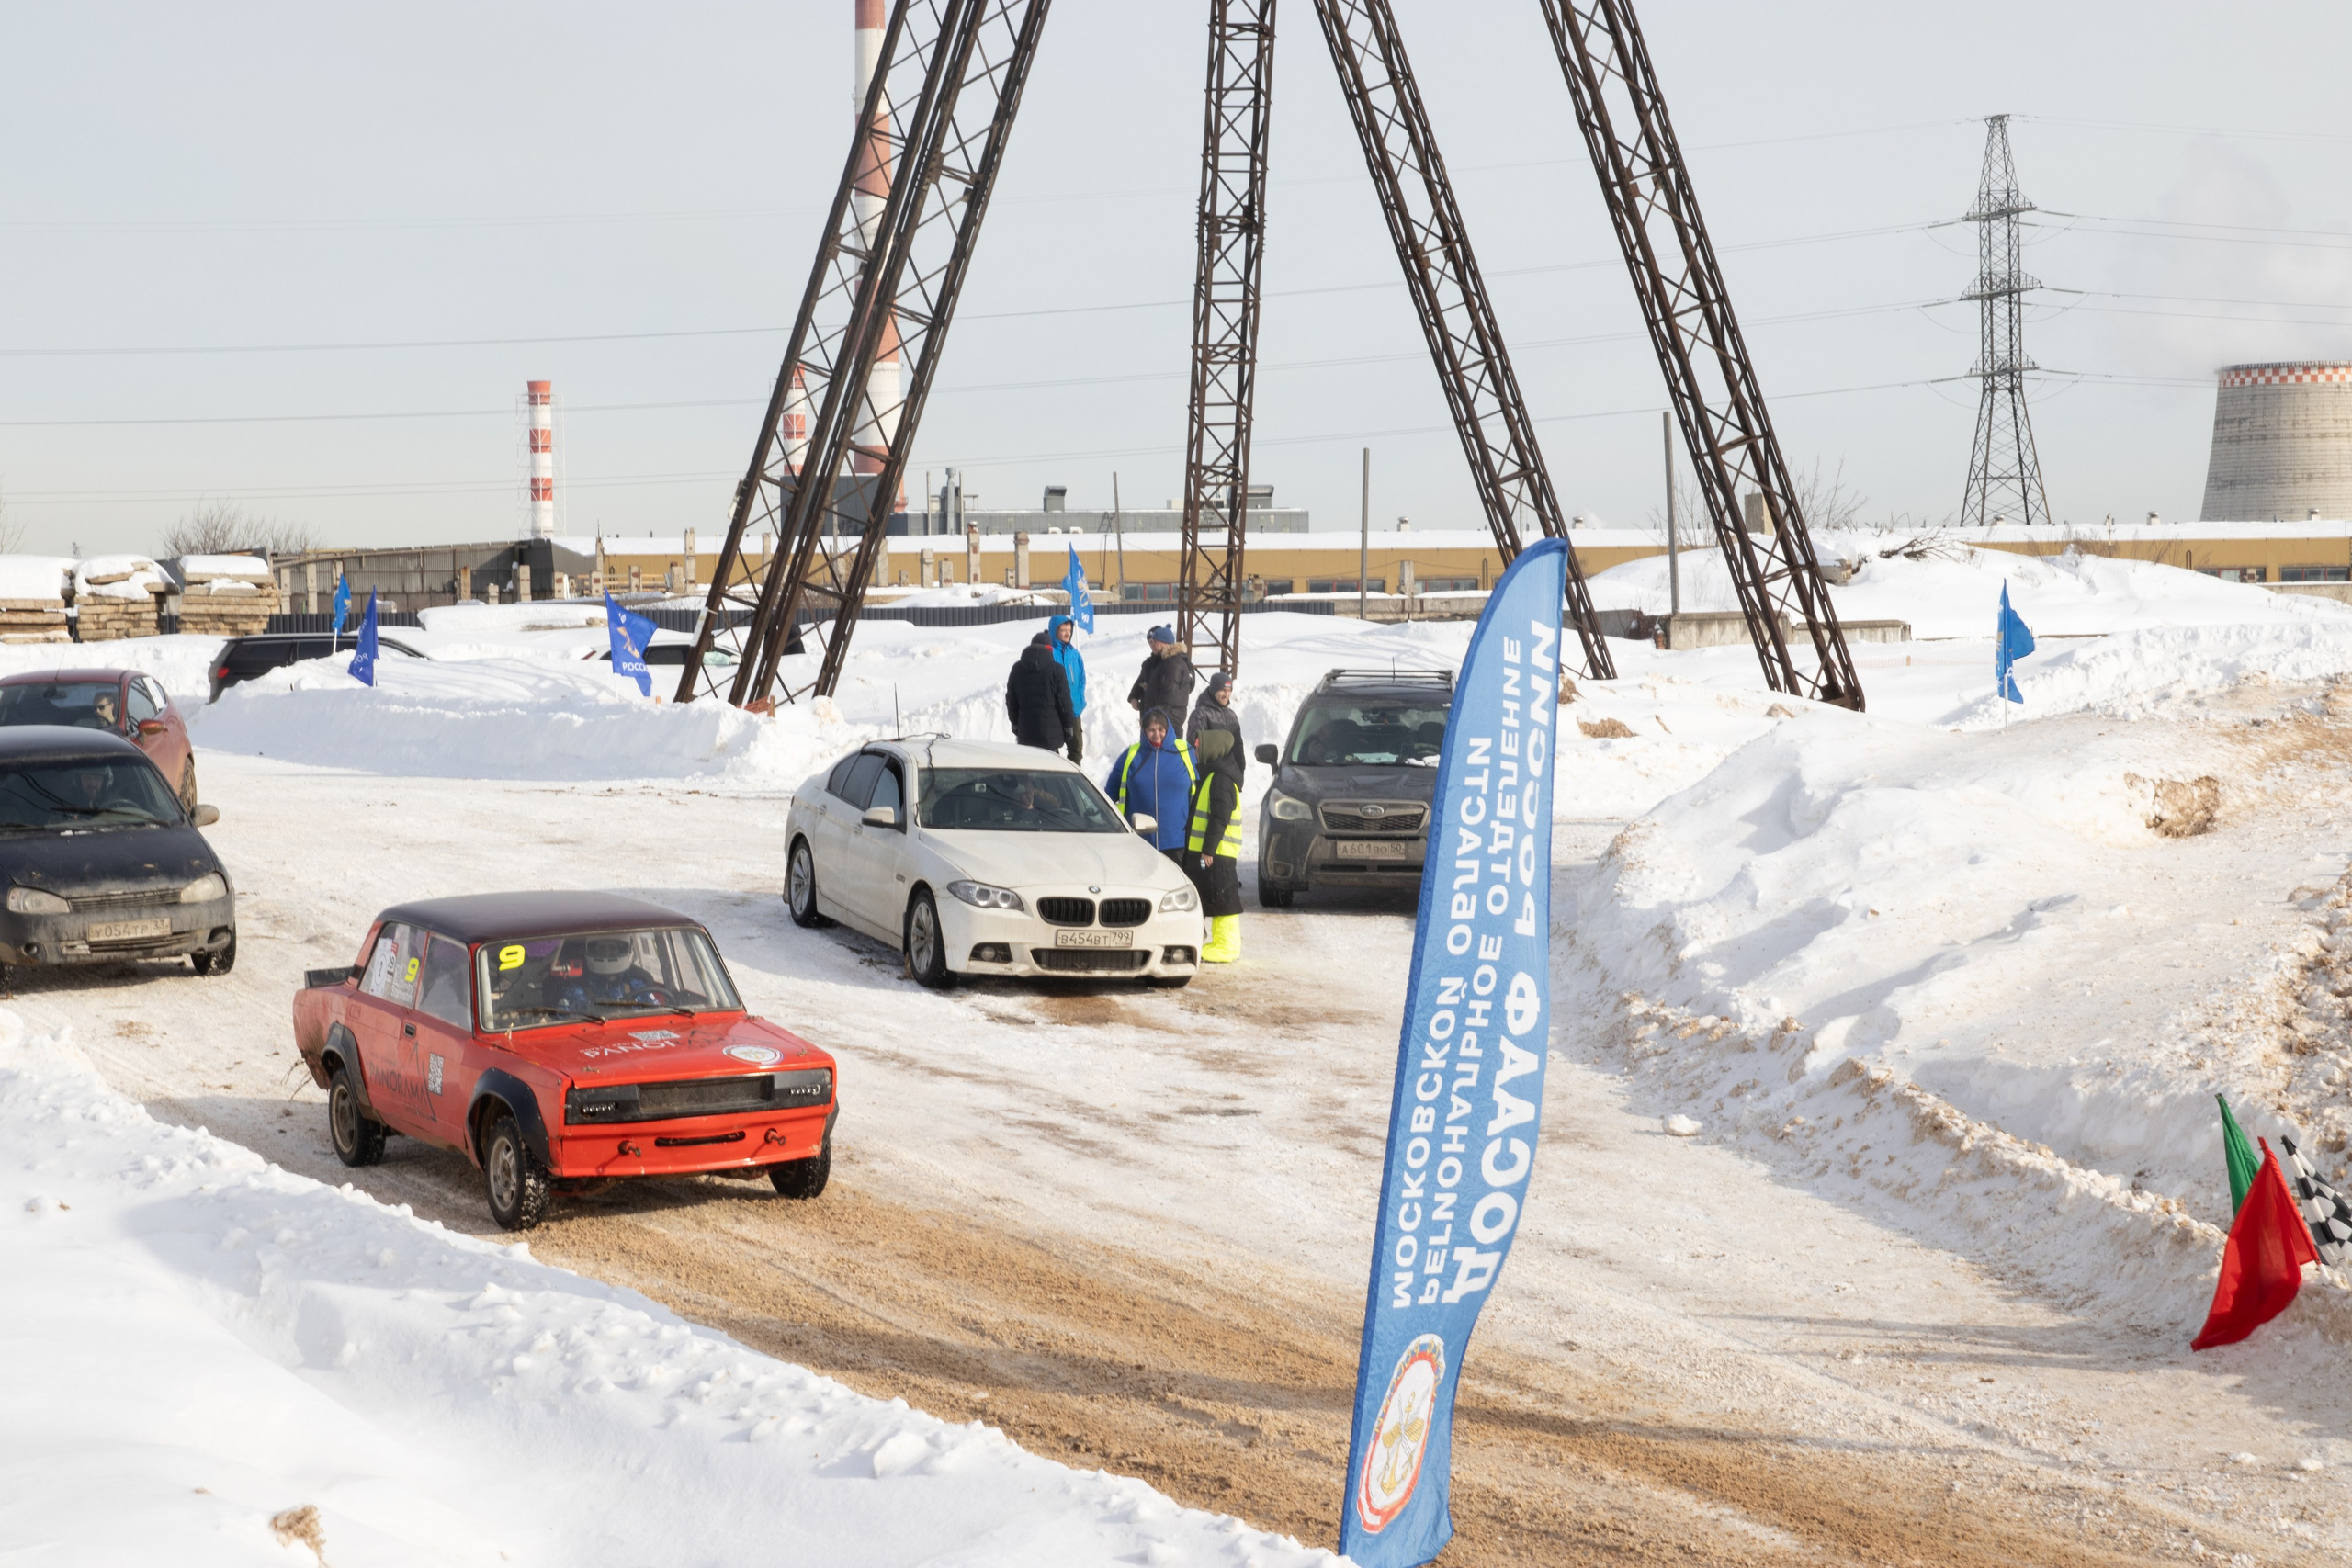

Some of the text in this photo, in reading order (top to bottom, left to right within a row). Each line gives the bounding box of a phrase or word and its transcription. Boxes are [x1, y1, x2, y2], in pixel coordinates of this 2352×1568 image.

[1390, 843, 1402, 852] 50
[95, 923, 148, 938] У054ТР
[153, 919, 165, 930] 33
[1060, 931, 1109, 945] В454ВТ
[1112, 931, 1130, 942] 799
[499, 944, 526, 971] 9
[404, 956, 420, 983] 9
[369, 1061, 428, 1106] PANORAMA
